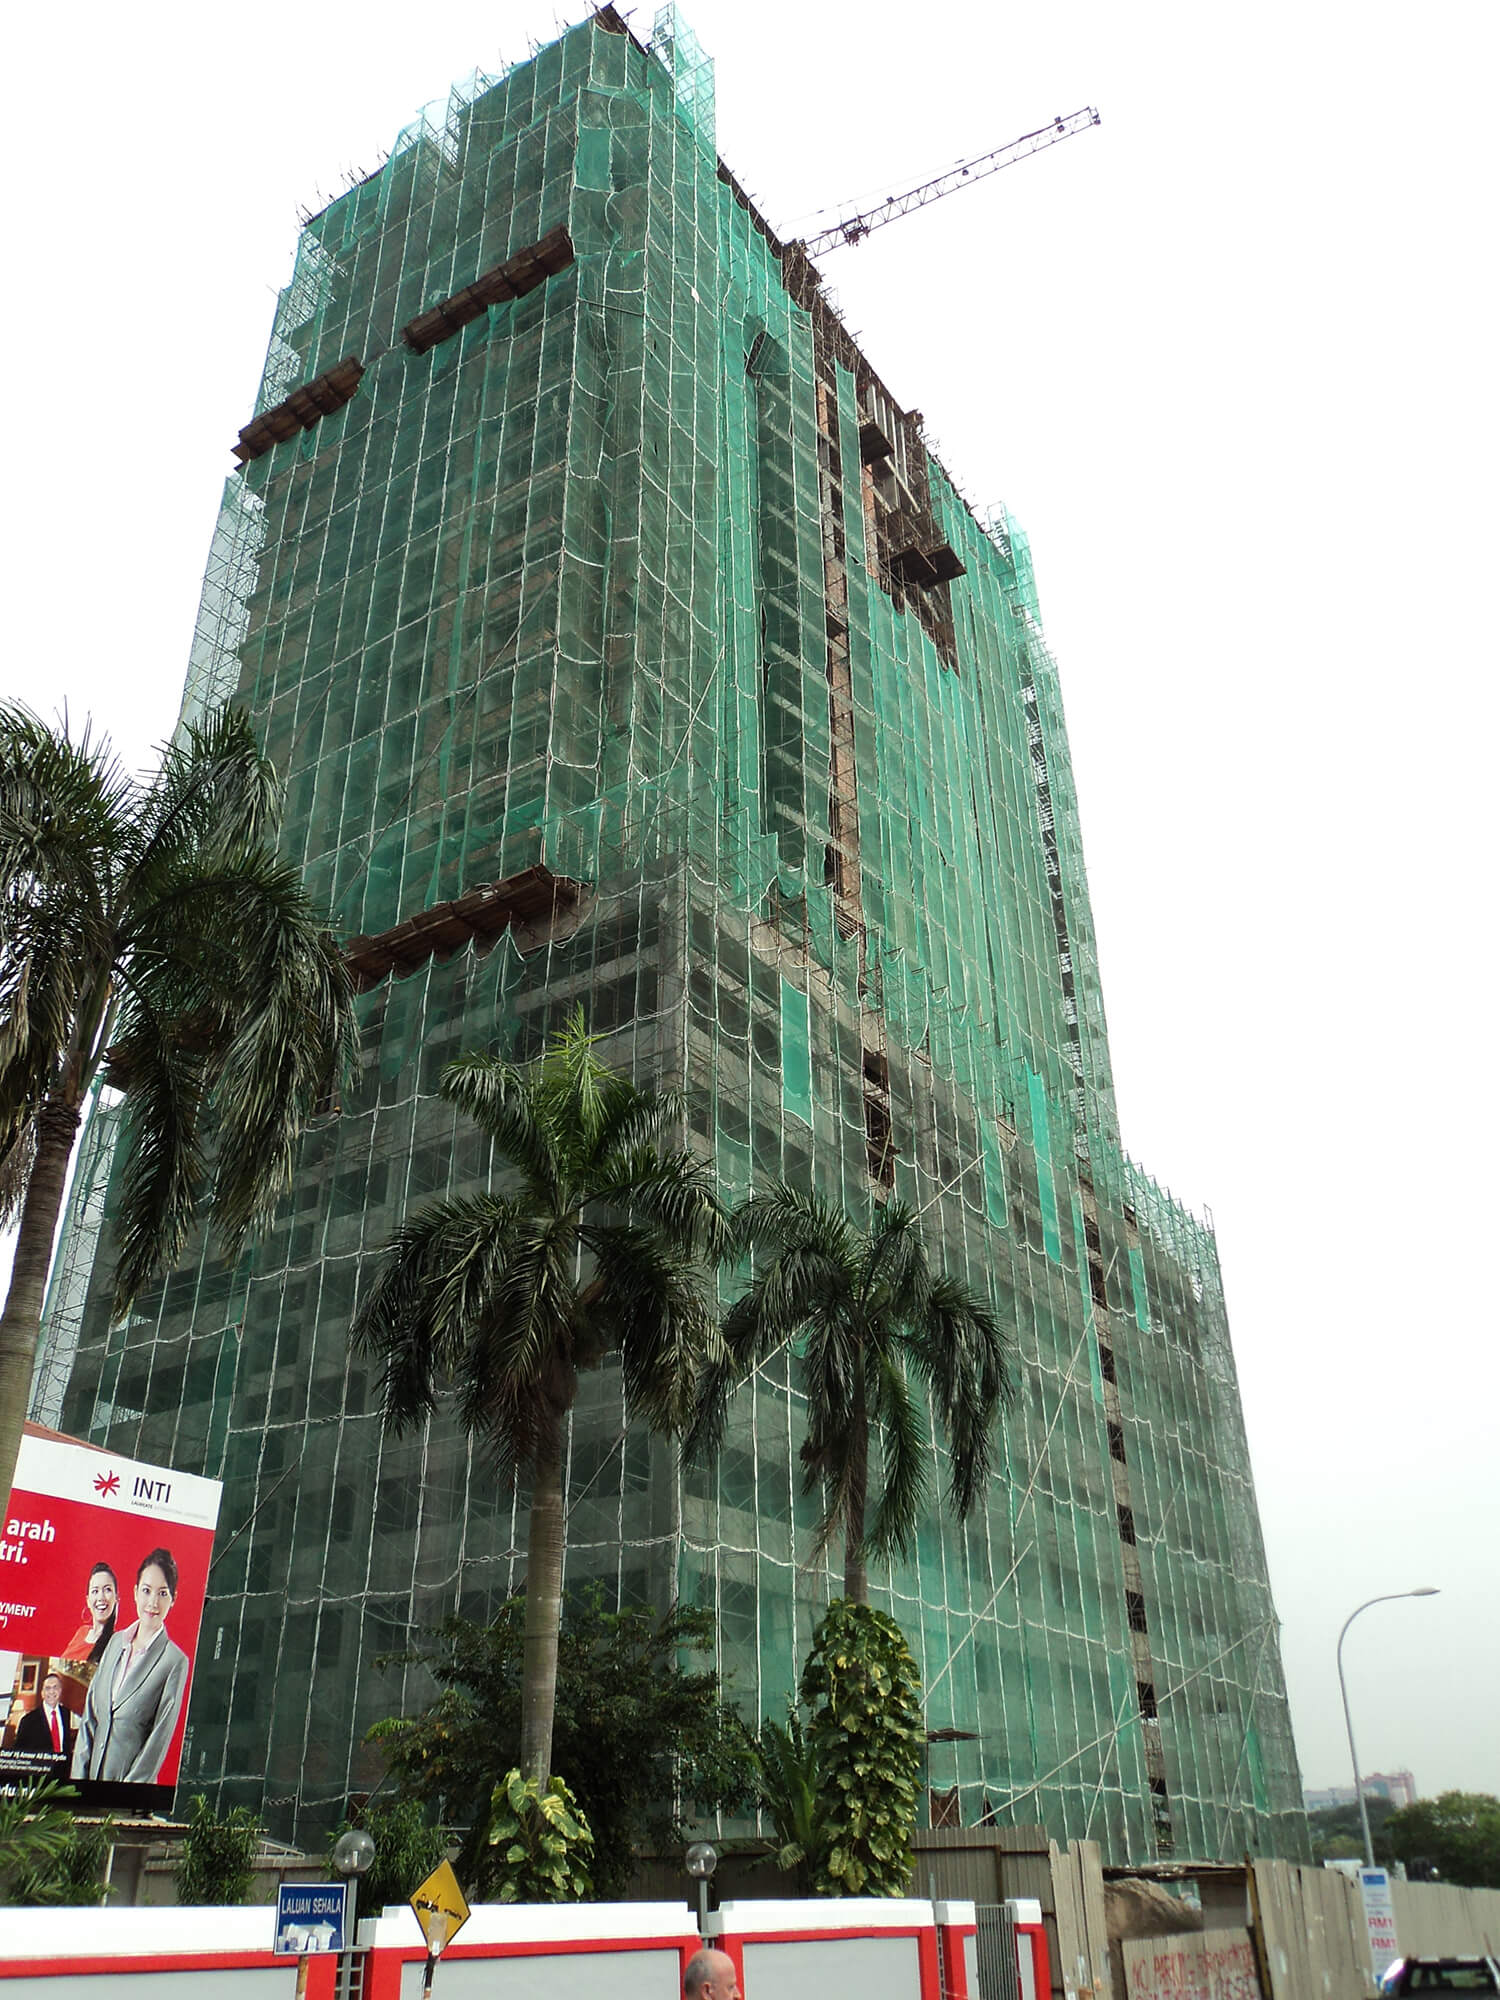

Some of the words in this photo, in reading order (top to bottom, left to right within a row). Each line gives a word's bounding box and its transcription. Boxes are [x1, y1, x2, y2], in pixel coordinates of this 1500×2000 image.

[133, 1476, 172, 1504] INTI
[6, 1519, 56, 1543] arah
[281, 1897, 311, 1914] LALUAN
[312, 1897, 341, 1913] SEHALA
